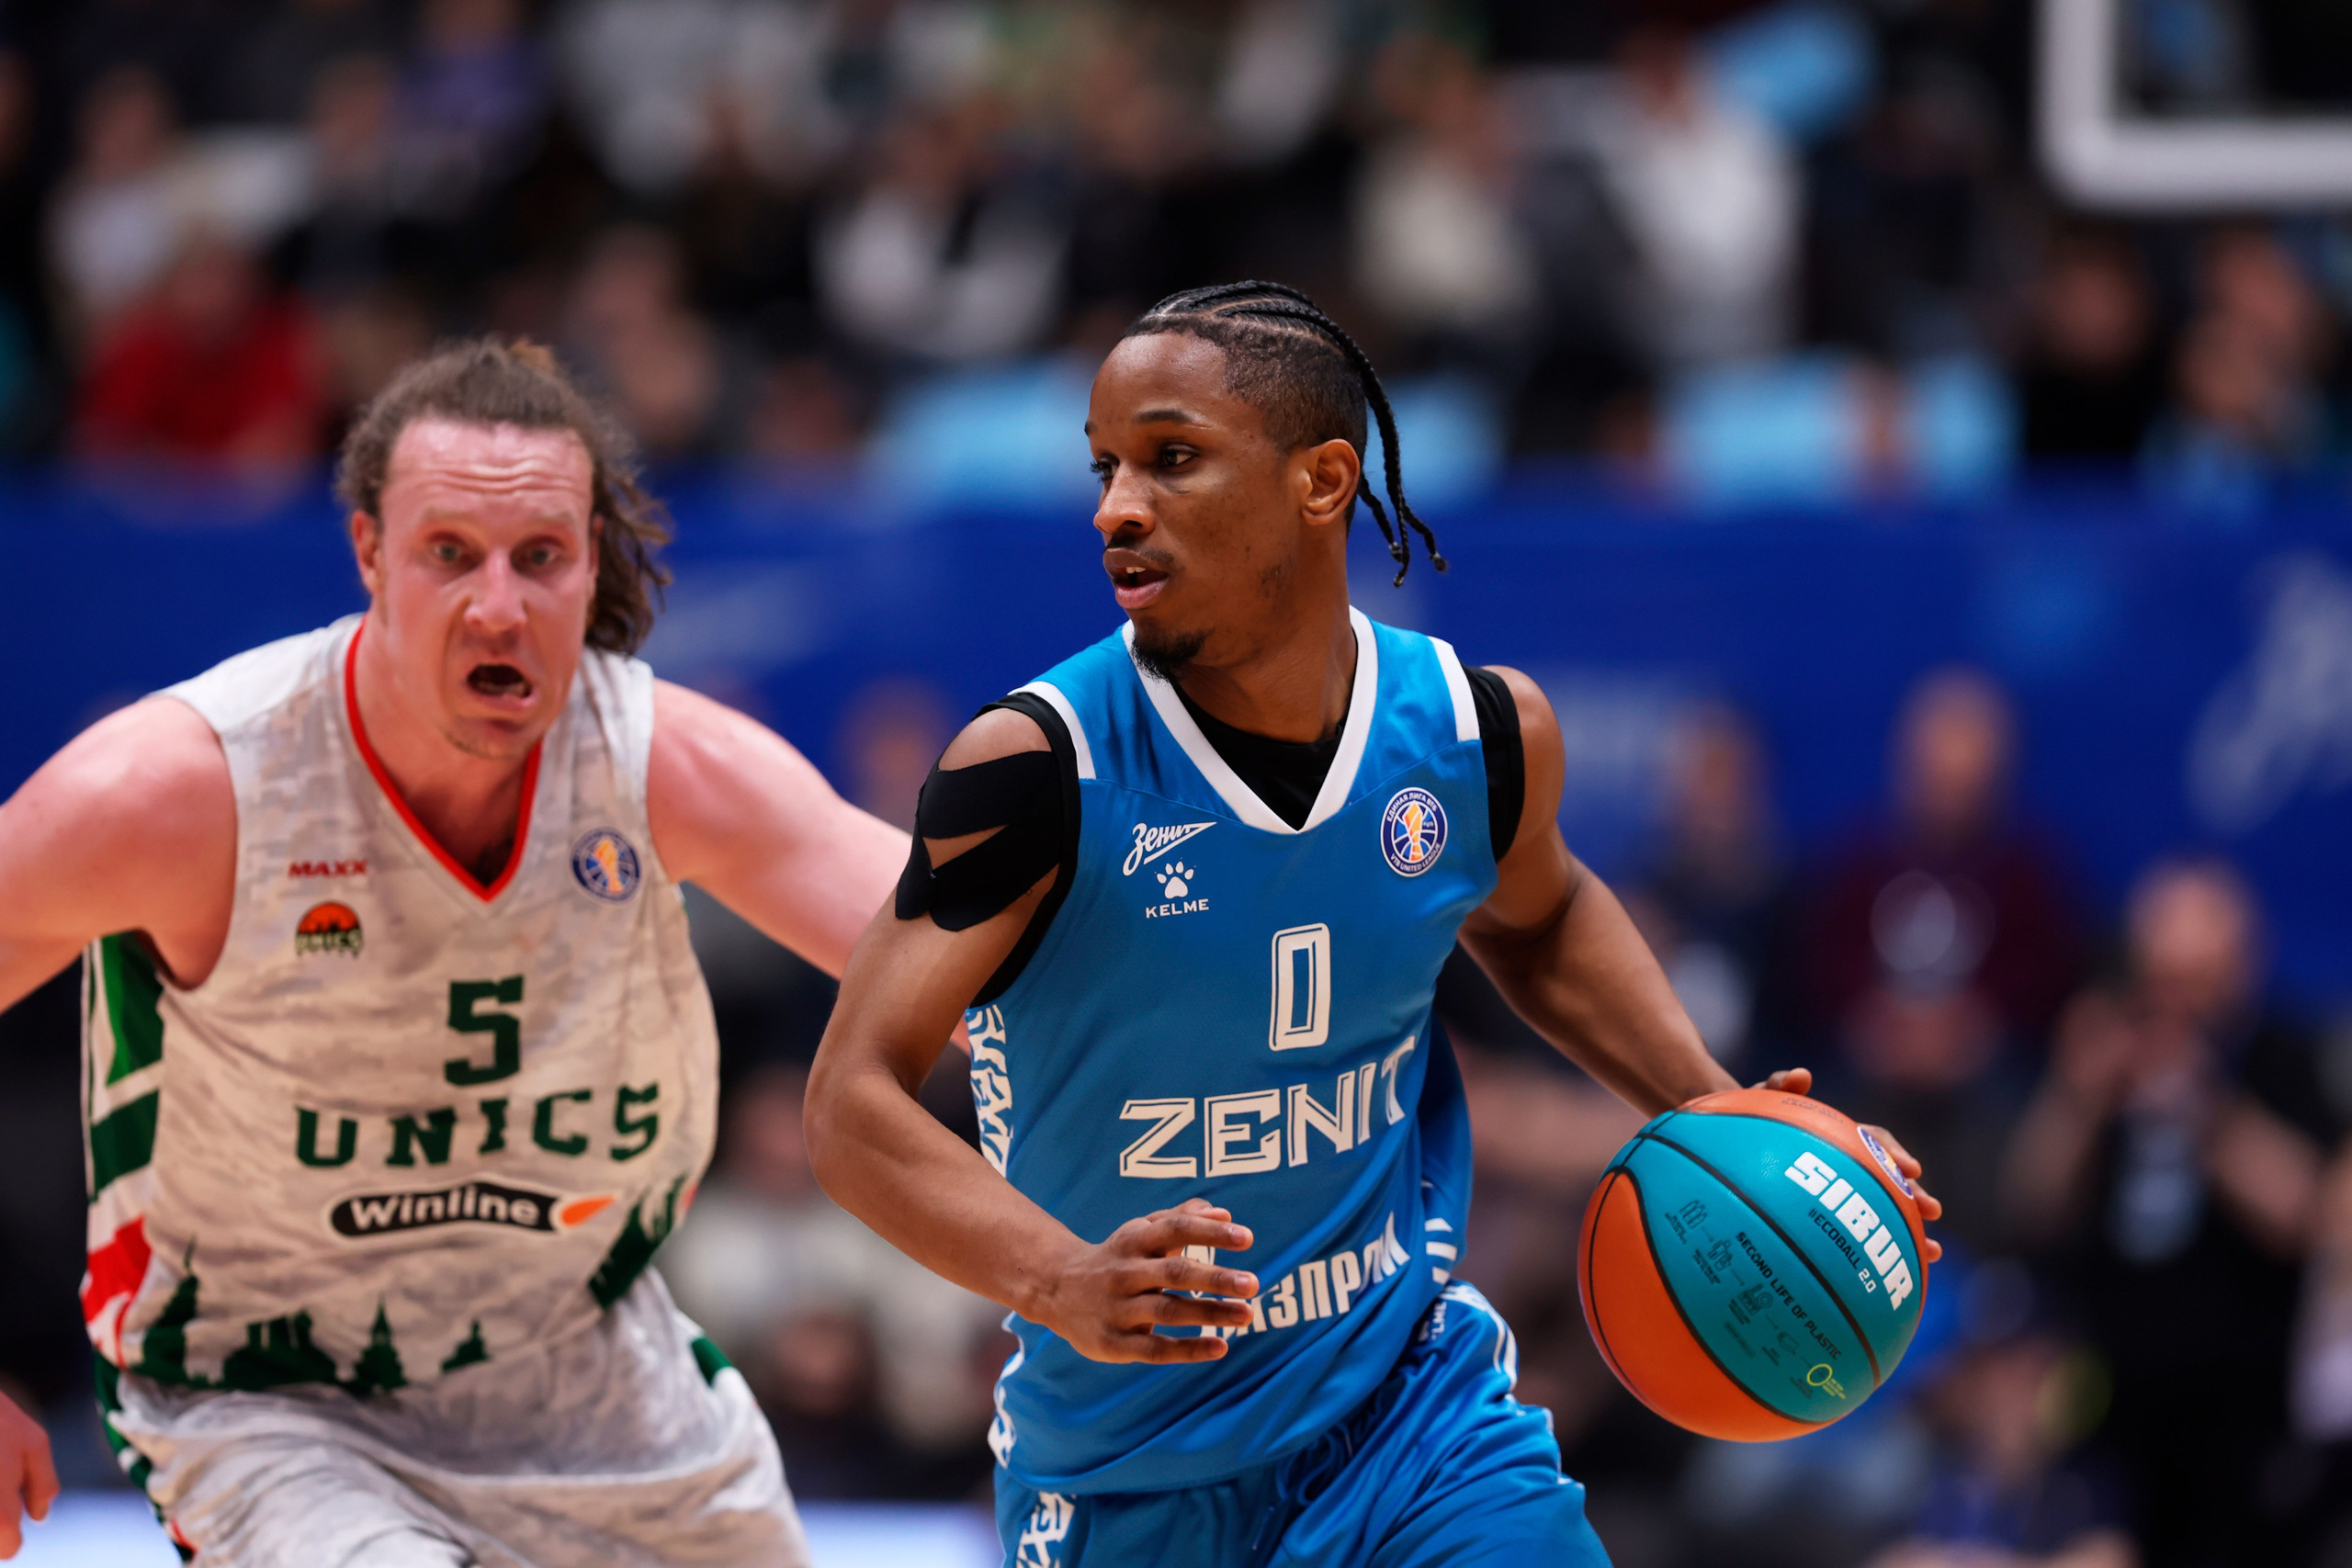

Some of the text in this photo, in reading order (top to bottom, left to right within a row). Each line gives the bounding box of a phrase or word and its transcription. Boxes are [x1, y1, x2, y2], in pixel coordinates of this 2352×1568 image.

[1386, 794, 1409, 822] ЕДИНАЯ
[288, 859, 368, 879] MAXX
[1399, 863, 1422, 873] UNITED
[1421, 843, 1442, 867] LEAGUE
[1145, 898, 1210, 919] KELME
[1269, 922, 1331, 1052] 0
[445, 975, 525, 1088] 5
[294, 1081, 660, 1168] UNICS
[1119, 1034, 1416, 1179] ZENIT
[349, 1185, 542, 1231] Winline
[1784, 1151, 1914, 1311] SIBUR
[1808, 1208, 1877, 1293] #ECOBALL 2.0
[1736, 1232, 1773, 1279] SECOND
[1770, 1278, 1795, 1307] LIFE
[1791, 1304, 1808, 1321] OF
[1804, 1320, 1842, 1360] PLASTIC
